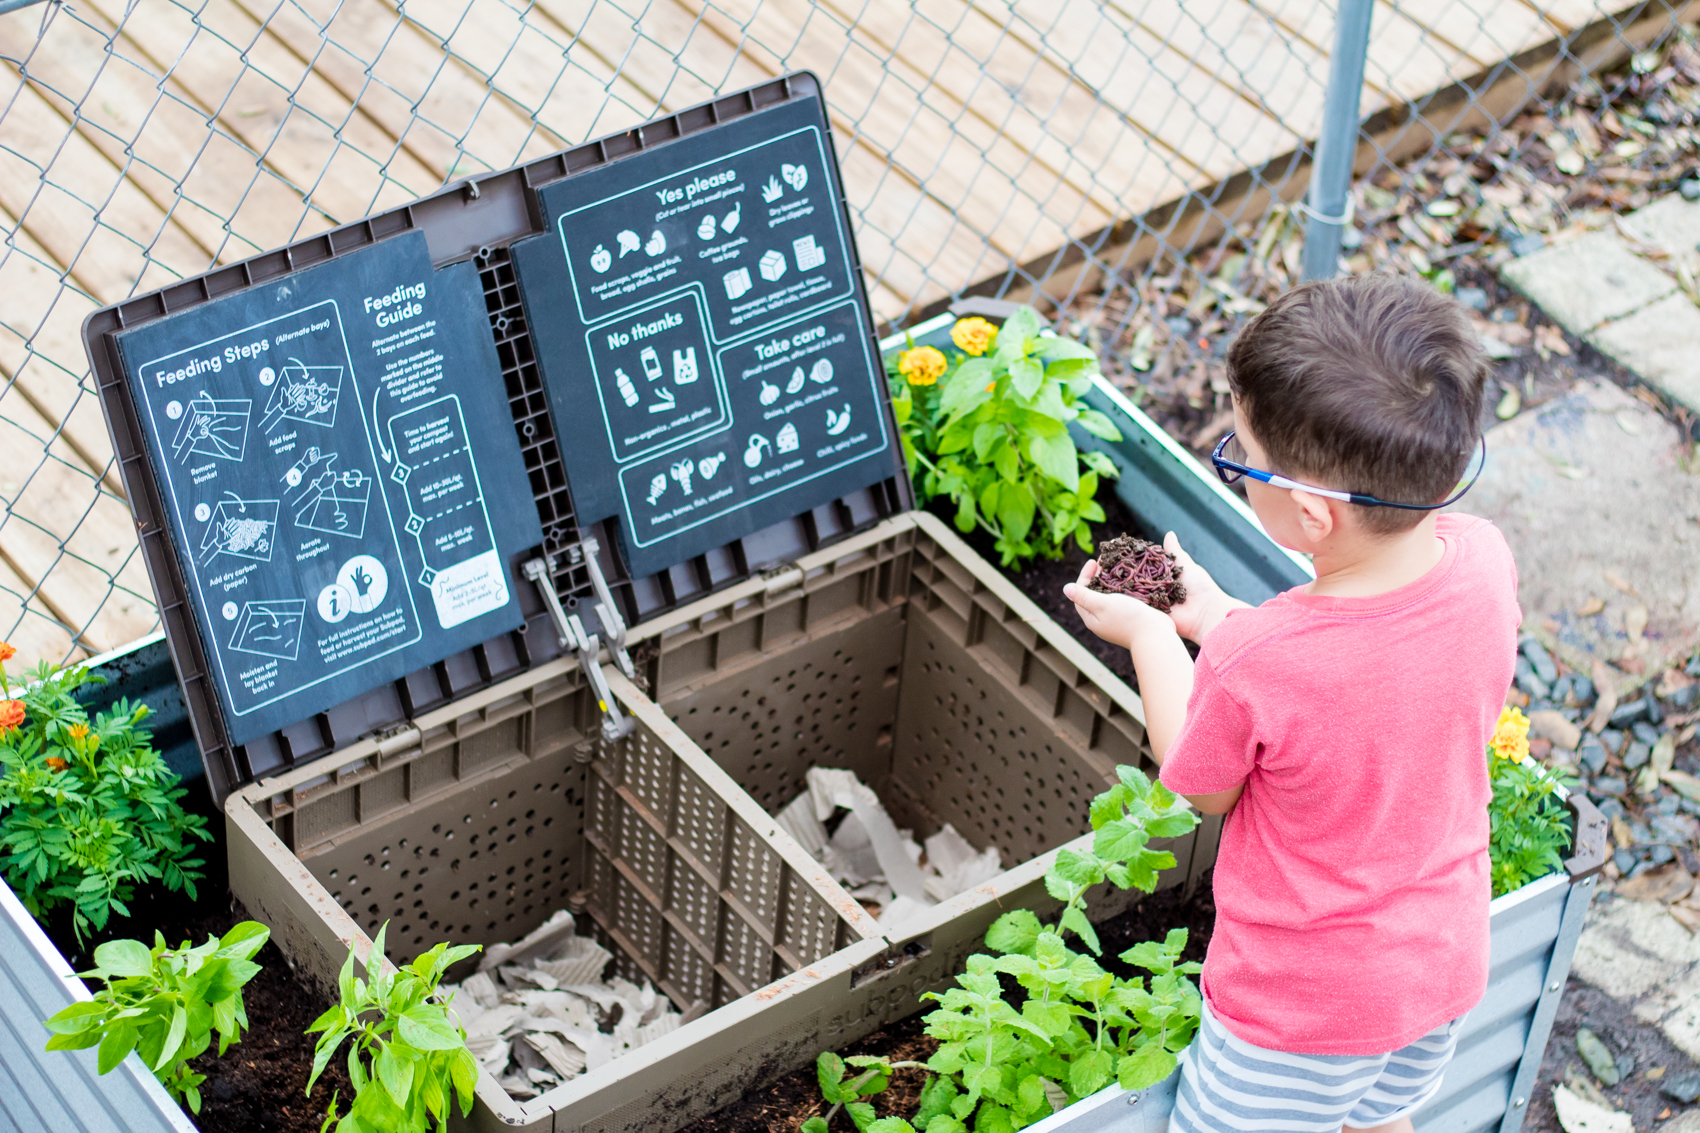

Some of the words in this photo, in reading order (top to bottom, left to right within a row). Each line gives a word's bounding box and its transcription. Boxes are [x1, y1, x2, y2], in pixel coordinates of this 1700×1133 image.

[656, 188, 684, 206] Yes
[685, 170, 736, 200] please
[669, 208, 677, 216] or
[677, 203, 690, 212] tear
[691, 198, 704, 208] into
[704, 190, 722, 204] small
[780, 200, 801, 212] leaves
[801, 197, 809, 206] or
[768, 216, 786, 228] grass
[698, 246, 720, 259] Coffee
[712, 255, 723, 264] tea
[723, 249, 740, 260] bags
[591, 282, 608, 294] Food
[608, 276, 631, 289] scraps,
[630, 266, 652, 280] veggie
[653, 260, 666, 271] and
[600, 287, 622, 300] bread,
[622, 283, 636, 293] egg
[656, 268, 677, 282] grains
[364, 282, 427, 314] Feeding
[729, 316, 743, 326] egg
[799, 280, 832, 299] cardboard
[768, 289, 786, 302] paper
[376, 301, 422, 328] Guide
[372, 334, 400, 348] Alternate
[400, 324, 426, 338] between
[426, 320, 436, 328] the
[607, 332, 630, 350] No
[631, 312, 684, 341] thanks
[376, 348, 380, 356] 2
[381, 344, 396, 354] bays
[404, 334, 420, 346] each
[754, 338, 790, 360] Take
[792, 325, 826, 346] care
[155, 355, 222, 388] Feeding
[224, 339, 270, 363] Steps
[276, 326, 310, 345] (Alternate
[311, 319, 330, 332] bays)
[386, 362, 398, 371] Use
[398, 358, 408, 366] the
[408, 348, 434, 362] numbers
[264, 372, 271, 382] 2
[381, 368, 404, 382] marked
[404, 366, 412, 374] on
[412, 362, 422, 370] the
[423, 354, 444, 366] middle
[387, 377, 407, 390] divider
[408, 371, 420, 382] and
[420, 367, 434, 377] refer
[435, 364, 442, 372] to
[390, 388, 401, 398] this
[402, 382, 418, 395] guide
[426, 372, 443, 384] avoid
[670, 414, 691, 428] metal,
[690, 406, 712, 422] plastic
[404, 428, 419, 438] Time
[426, 416, 449, 430] harvest
[410, 436, 422, 446] your
[424, 424, 448, 439] compost
[269, 438, 282, 448] Add
[282, 430, 297, 442] food
[274, 442, 296, 454] scraps
[408, 444, 420, 454] and
[420, 438, 434, 450] start
[850, 432, 868, 445] foods
[190, 462, 216, 476] Remove
[398, 468, 404, 478] 3
[782, 458, 804, 472] cheese
[194, 470, 218, 485] blanket
[292, 473, 298, 482] 4
[420, 484, 432, 495] Add
[438, 488, 448, 498] per
[448, 481, 464, 492] week
[708, 485, 734, 502] seafood
[411, 519, 418, 530] 2
[300, 538, 321, 551] Aerate
[435, 536, 448, 546] Add
[440, 542, 456, 552] max.
[457, 534, 473, 545] week
[296, 542, 330, 562] throughout
[210, 575, 222, 587] Add
[223, 571, 234, 580] dry
[234, 564, 258, 577] carbon
[224, 576, 248, 592] (paper)
[426, 572, 431, 582] 1
[446, 580, 472, 593] Minimum
[474, 571, 488, 583] Level
[318, 638, 328, 648] For
[328, 632, 338, 643] full
[338, 620, 374, 638] instructions
[374, 616, 382, 624] on
[382, 610, 396, 620] how
[396, 606, 404, 616] to
[320, 645, 334, 656] feed
[335, 642, 342, 650] or
[342, 632, 366, 646] harvest
[366, 627, 380, 638] your
[324, 653, 337, 664] visit
[337, 624, 406, 658] www.subpod.com/start
[240, 666, 264, 680] Moisten
[265, 658, 278, 670] and
[244, 679, 254, 688] lay
[254, 669, 278, 684] blanket
[252, 684, 268, 694] back
[268, 680, 275, 688] in
